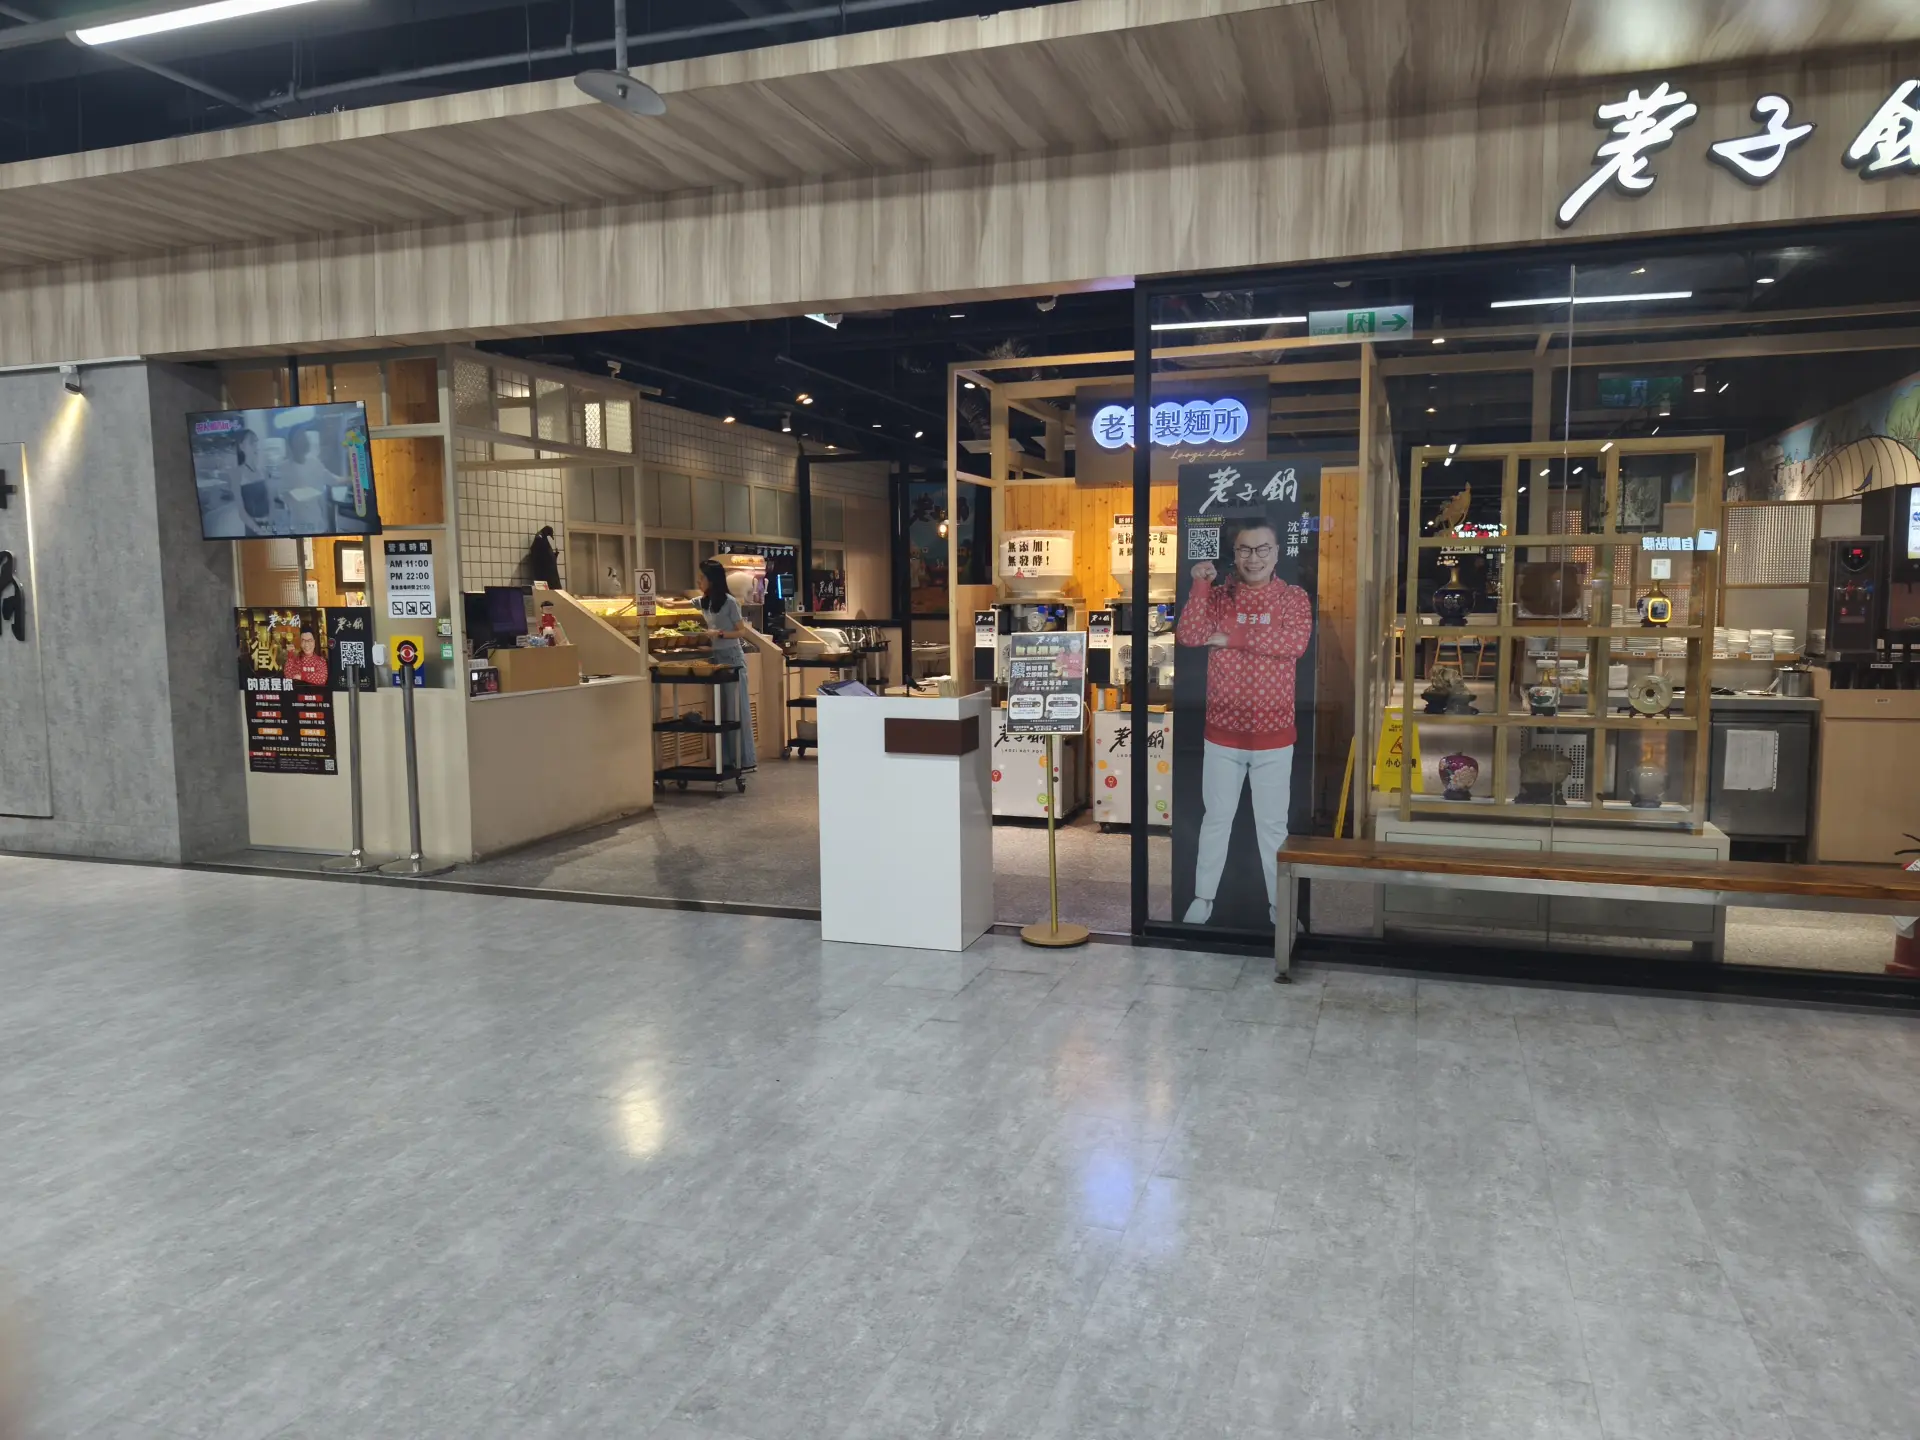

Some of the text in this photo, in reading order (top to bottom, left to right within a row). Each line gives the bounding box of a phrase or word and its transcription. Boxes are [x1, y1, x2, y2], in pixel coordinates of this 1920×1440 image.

[1286, 521, 1300, 557] 沈玉琳
[388, 542, 428, 553] 營業時間
[390, 559, 428, 568] AM 11:00
[390, 572, 429, 580] PM 22:00
[251, 640, 280, 671] 徵
[247, 678, 294, 691] 的就是你
[1386, 757, 1417, 768] 小心滑
